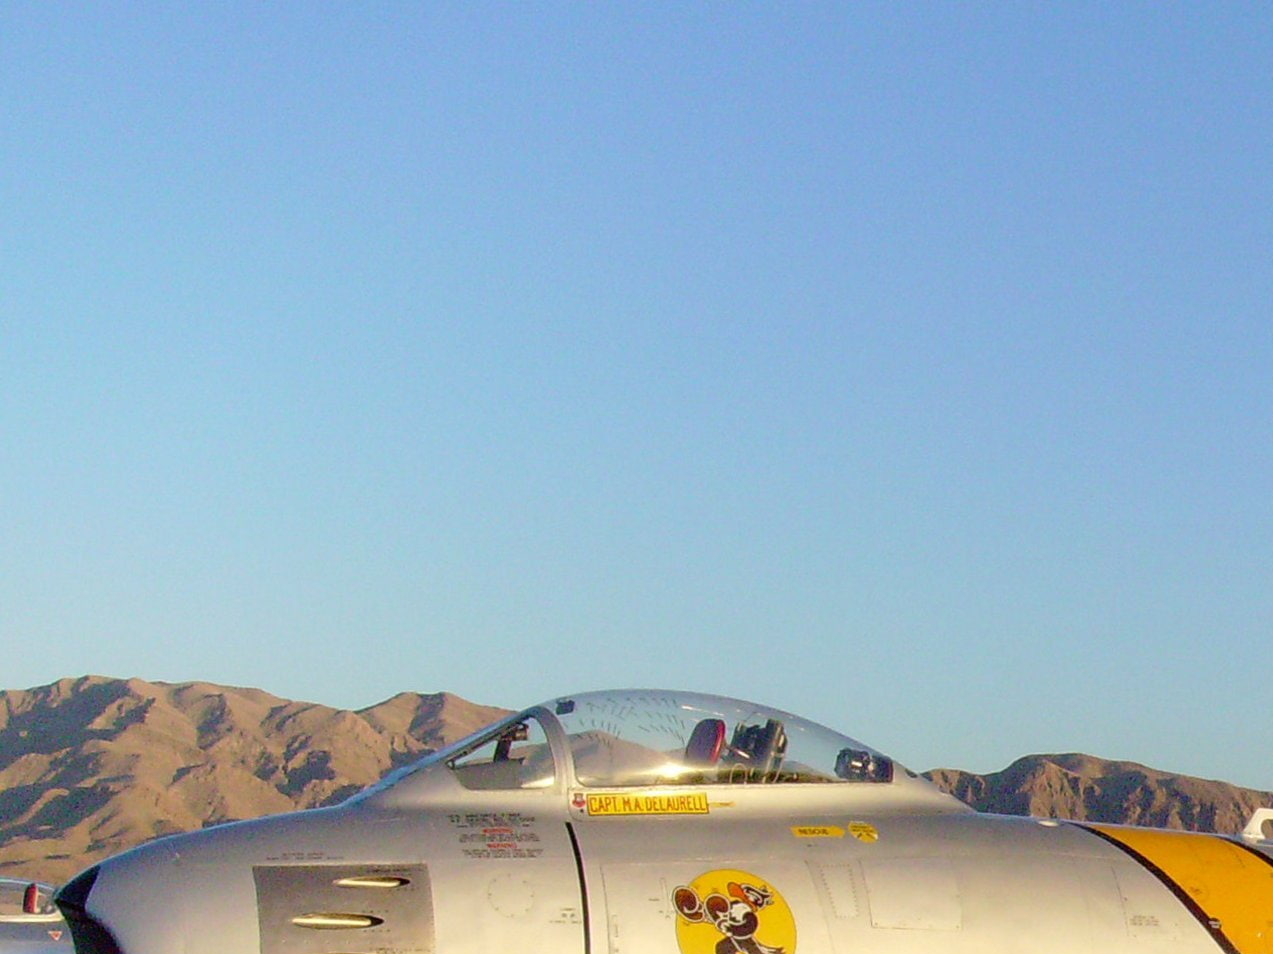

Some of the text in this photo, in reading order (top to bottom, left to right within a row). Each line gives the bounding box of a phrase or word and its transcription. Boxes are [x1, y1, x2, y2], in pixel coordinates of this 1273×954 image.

[589, 794, 706, 813] CAPT. M.A. DELAURELL
